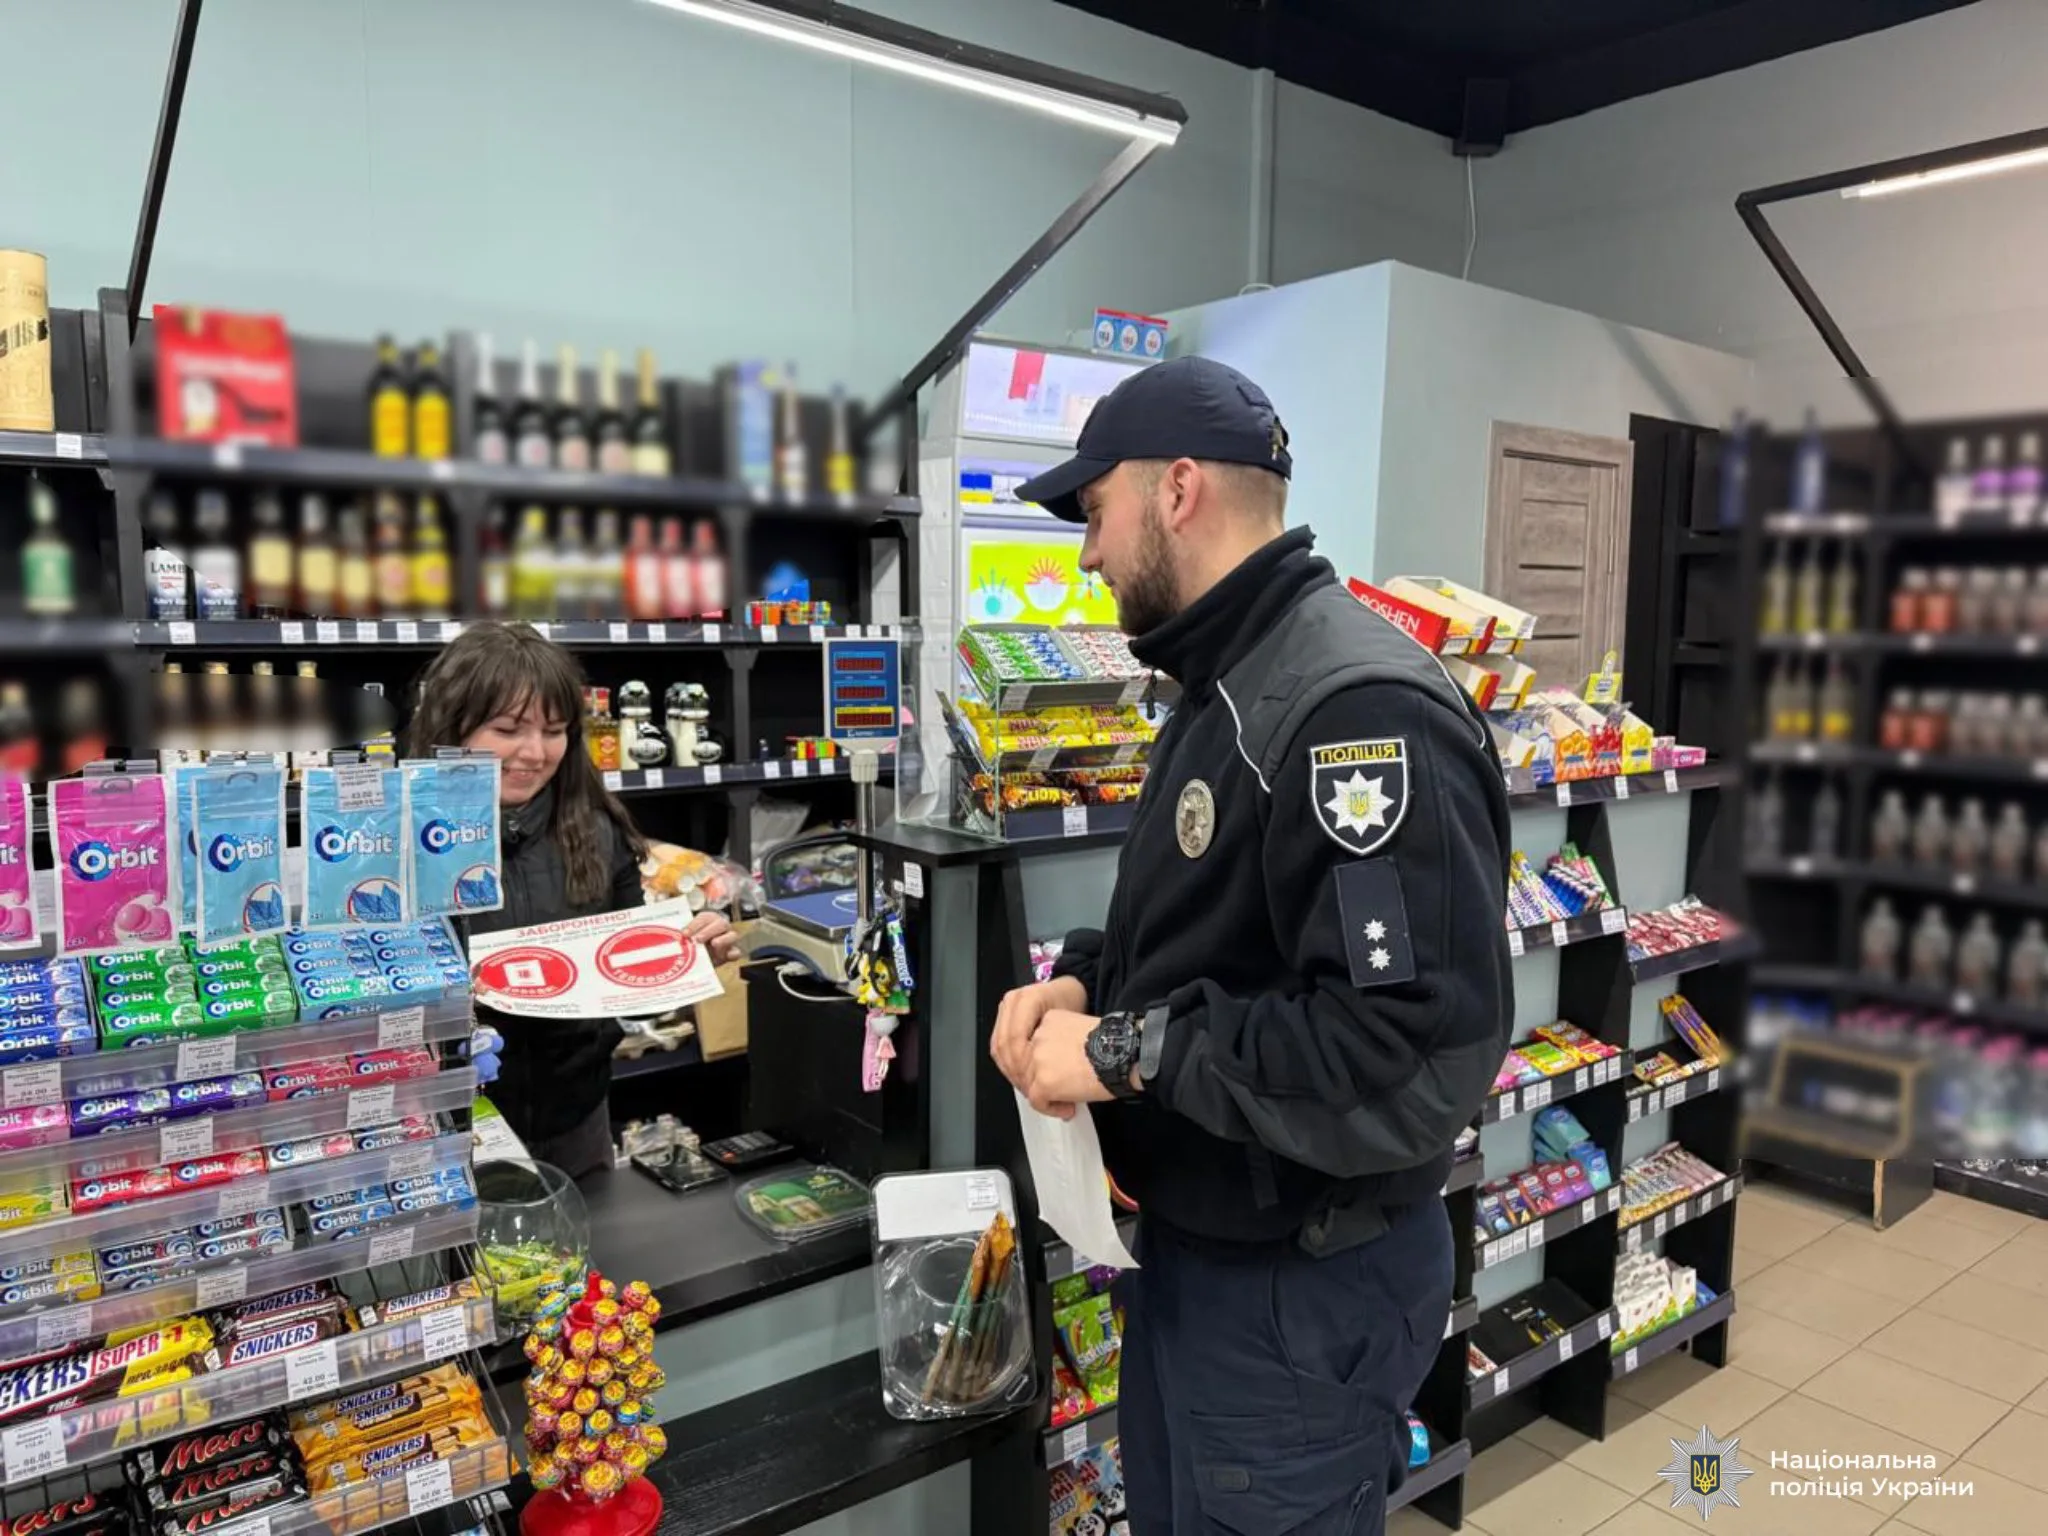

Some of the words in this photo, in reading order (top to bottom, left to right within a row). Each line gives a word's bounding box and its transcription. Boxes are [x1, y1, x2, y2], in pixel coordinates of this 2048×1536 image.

[1320, 743, 1396, 764] ПОЛІЦІЯ
[321, 832, 393, 856] Orbit
[427, 823, 489, 847] Orbit
[77, 845, 159, 874] Orbit
[216, 836, 274, 865] Orbit
[101, 952, 146, 966] Orbit
[202, 959, 247, 976] Orbit
[109, 970, 155, 984] Orbit
[206, 978, 252, 994] Orbit
[395, 975, 436, 988] Orbit
[108, 990, 155, 1005] Orbit
[310, 983, 352, 998] Orbit
[210, 998, 256, 1015] Orbit
[115, 1012, 161, 1028] Orbit
[0, 1034, 51, 1051] Orbit
[359, 1060, 400, 1074] Orbit
[275, 1073, 318, 1089] Orbit
[178, 1083, 223, 1099] Orbit
[80, 1098, 129, 1116] Orbit
[362, 1135, 404, 1149] Orbit
[180, 1161, 225, 1179] Orbit
[84, 1178, 132, 1199] Orbit
[395, 1176, 433, 1191] Orbit
[313, 1193, 355, 1207] Orbit
[401, 1194, 439, 1210] Orbit
[201, 1215, 245, 1235] Orbit
[319, 1211, 360, 1229] Orbit
[108, 1246, 155, 1264] Orbit
[204, 1239, 249, 1257] Orbit
[2, 1259, 56, 1280] Orbit
[4, 1282, 56, 1303] Orbit
[98, 1331, 160, 1371] SUPER
[233, 1323, 316, 1361] SNICKERS
[0, 1355, 87, 1411] CKERS
[339, 1384, 396, 1412] SNICKERS
[355, 1393, 413, 1423] SNICKERS
[160, 1420, 265, 1477] Mars
[364, 1435, 424, 1467] SNICKERS
[172, 1456, 276, 1505] Mars
